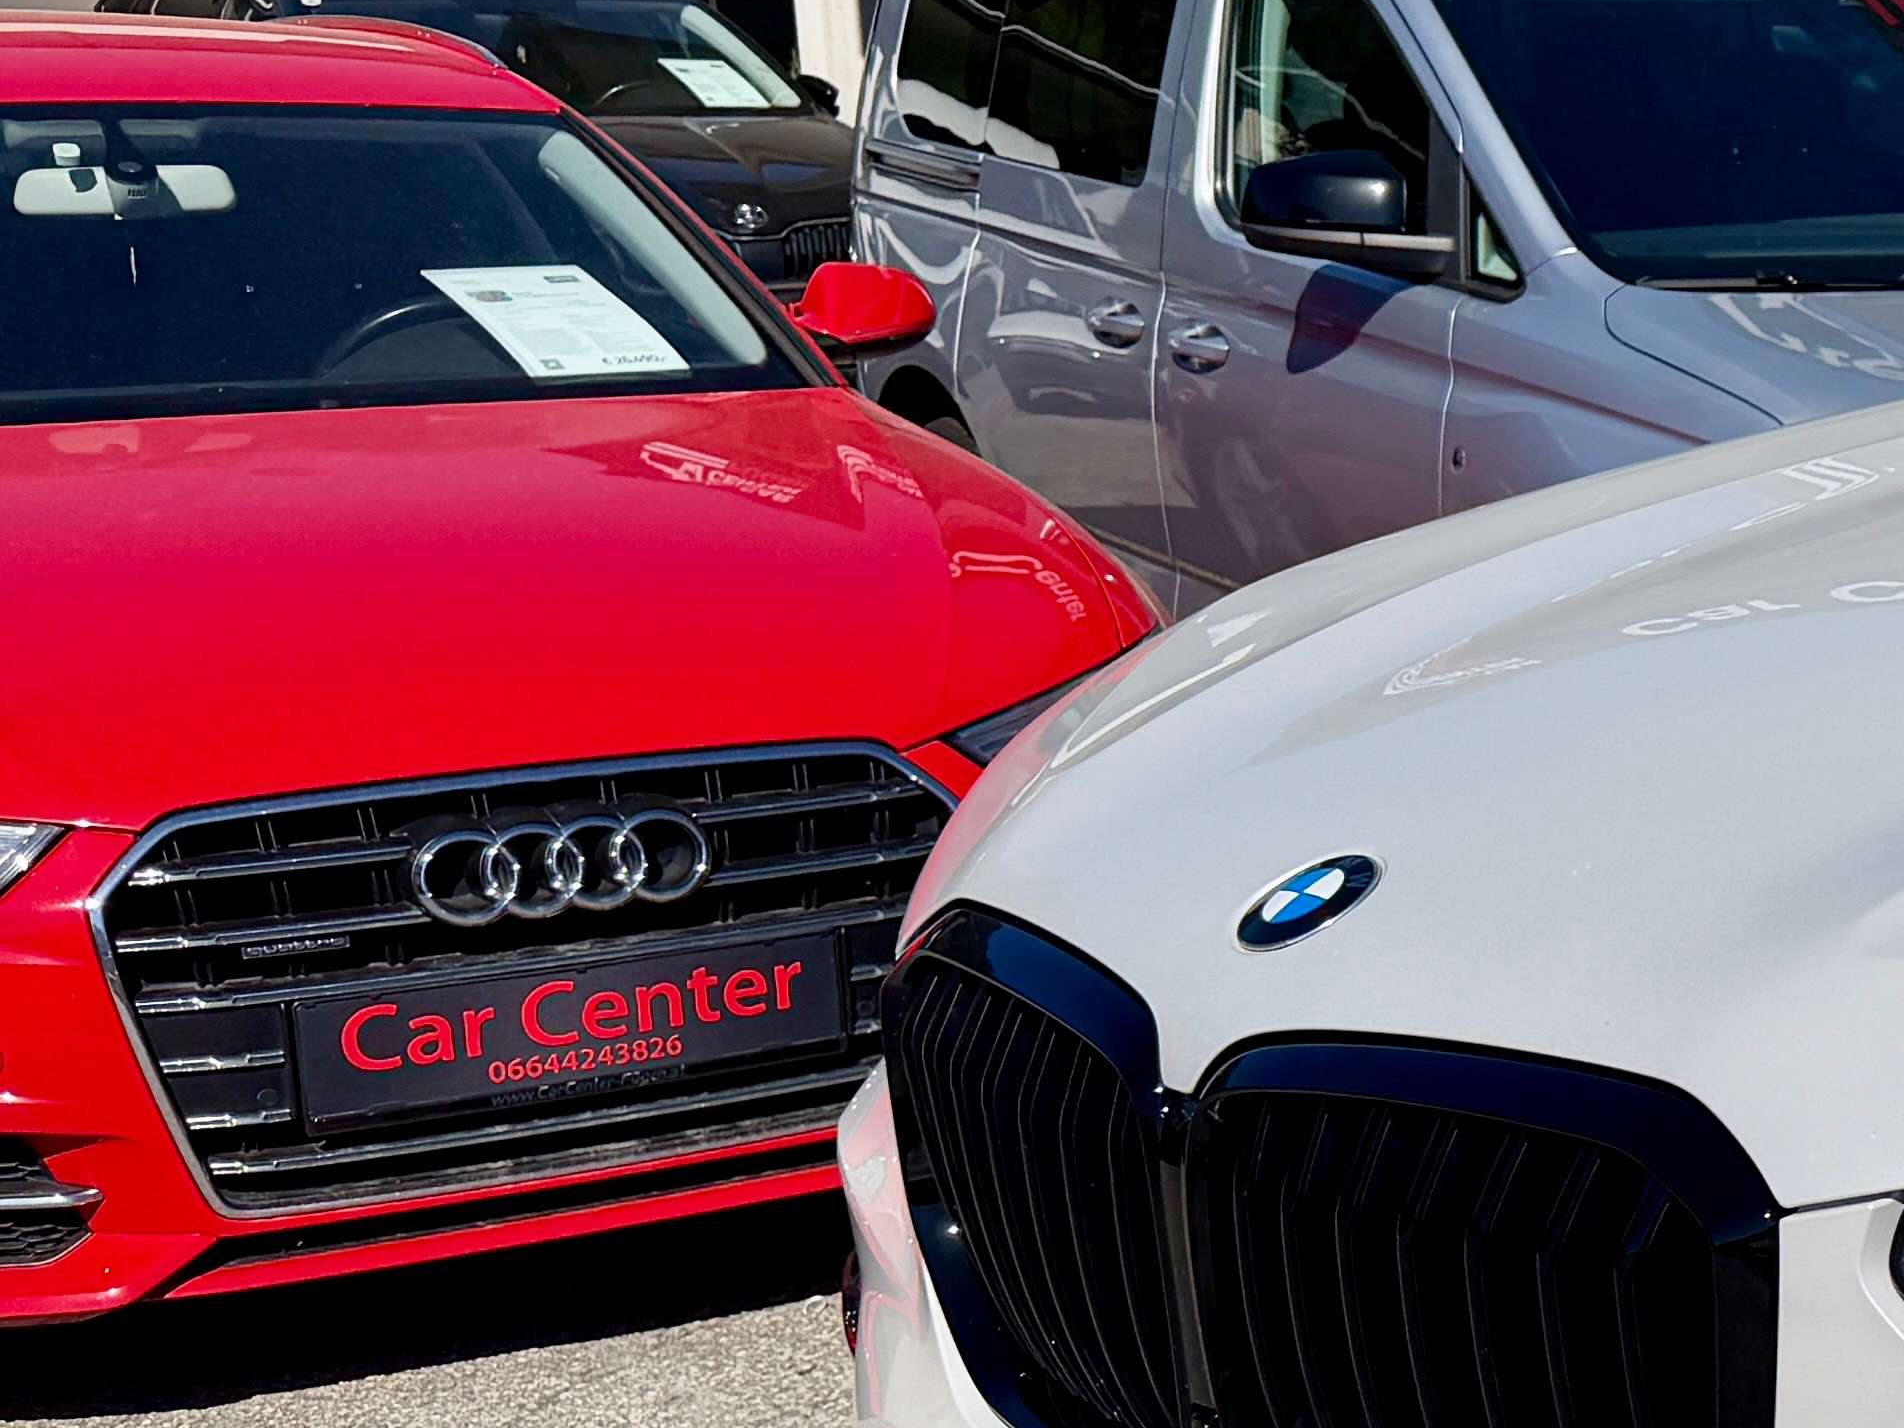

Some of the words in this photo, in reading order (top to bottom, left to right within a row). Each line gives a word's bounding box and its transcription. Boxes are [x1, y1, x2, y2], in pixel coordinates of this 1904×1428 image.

[340, 1003, 496, 1071] Car
[520, 961, 802, 1048] Center
[488, 1034, 683, 1085] 06644243826
